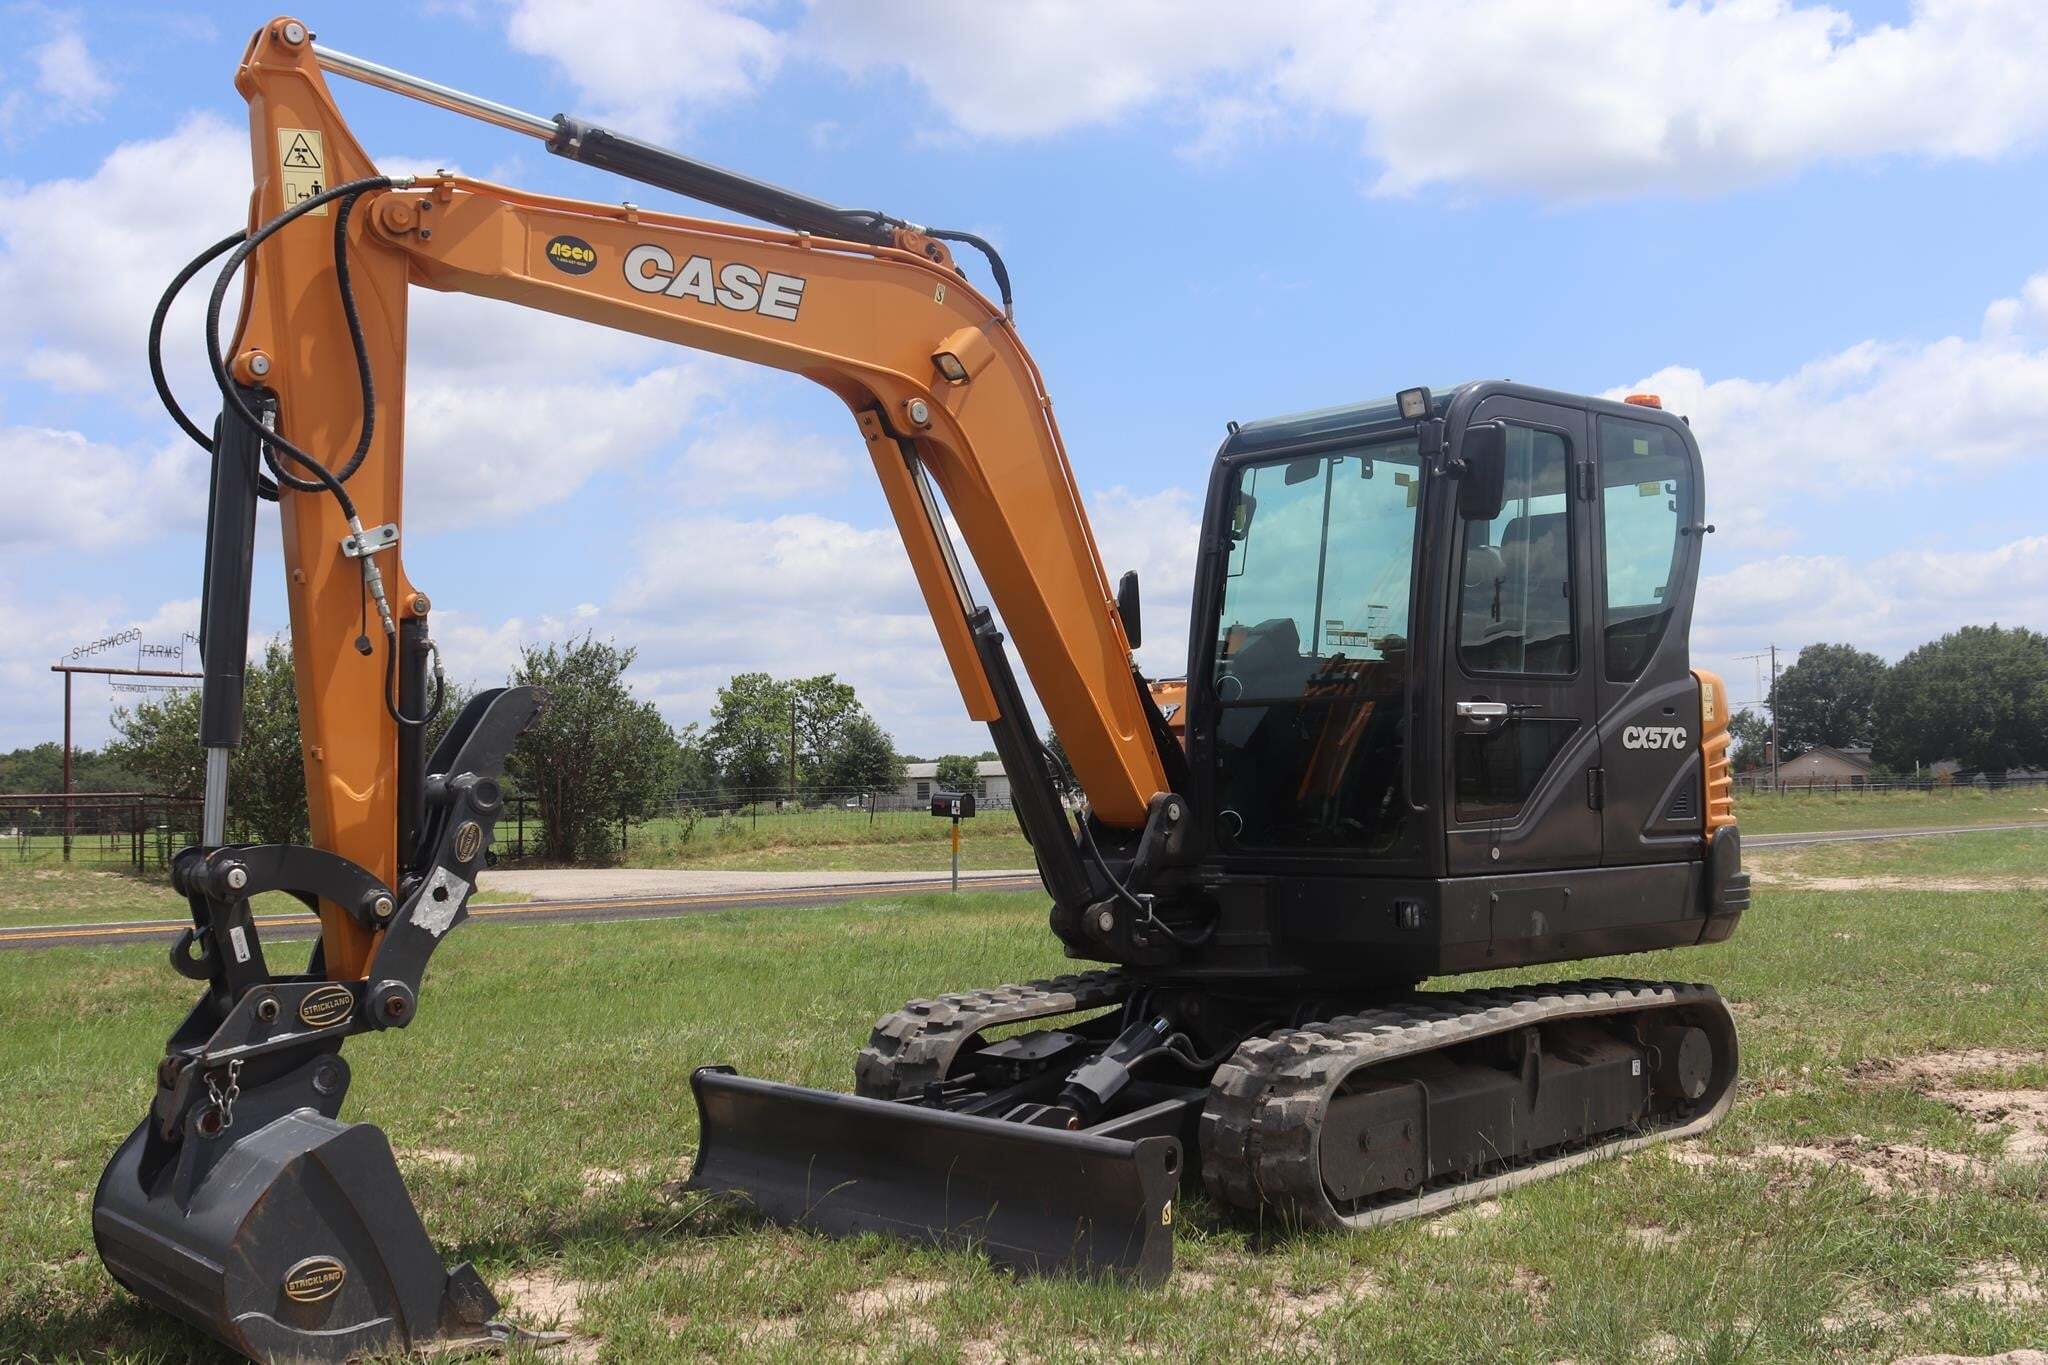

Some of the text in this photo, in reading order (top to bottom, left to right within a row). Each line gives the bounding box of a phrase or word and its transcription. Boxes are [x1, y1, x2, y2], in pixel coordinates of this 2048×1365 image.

[550, 242, 594, 262] ASCO
[623, 243, 806, 321] CASE
[72, 628, 140, 660] SHERWOOD
[142, 644, 181, 659] FARMS
[1622, 726, 1687, 749] CX57C
[303, 996, 350, 1016] STRICKLAND
[288, 1271, 341, 1291] STRICKLAND
